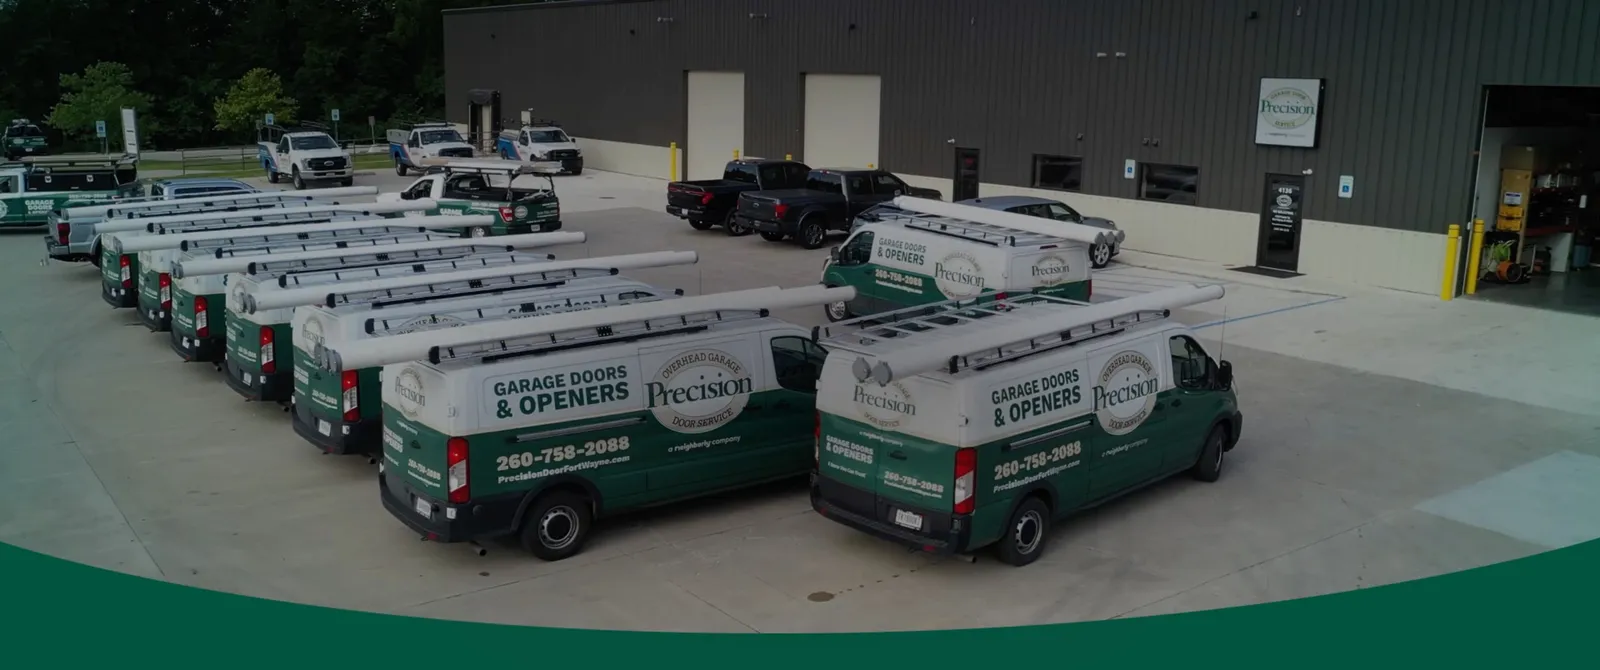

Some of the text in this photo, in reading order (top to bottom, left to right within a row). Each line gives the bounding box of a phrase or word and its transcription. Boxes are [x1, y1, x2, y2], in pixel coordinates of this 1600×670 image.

[1260, 99, 1315, 115] Precision
[877, 246, 924, 266] & OPENERS
[879, 238, 926, 253] GARAGE DOORS
[935, 262, 985, 287] Precision
[1031, 264, 1070, 276] Precision
[663, 353, 741, 379] OVERHEAD GARAGE
[1102, 355, 1152, 382] OVERHEAD GARAGE
[395, 376, 425, 406] Precision
[494, 365, 627, 396] GARAGE DOORS
[644, 372, 753, 408] Precision
[992, 369, 1079, 404] GARAGE DOORS
[1092, 374, 1158, 412] Precision
[496, 381, 629, 419] & OPENERS
[853, 385, 916, 415] Precision
[994, 385, 1081, 427] & OPENERS
[672, 408, 734, 428] DOOR SERVICE
[1108, 419, 1123, 430] DOOR
[496, 436, 630, 471] 260-758-2088
[674, 440, 711, 452] neighborly
[712, 436, 741, 445] company
[826, 435, 874, 455] GARAGE DOORS
[826, 442, 873, 464] & OPENERS
[498, 456, 630, 484] PrecisionDoorFortWayne.com
[994, 441, 1082, 480] 260-758-2088
[884, 471, 944, 493] 260-758-2088
